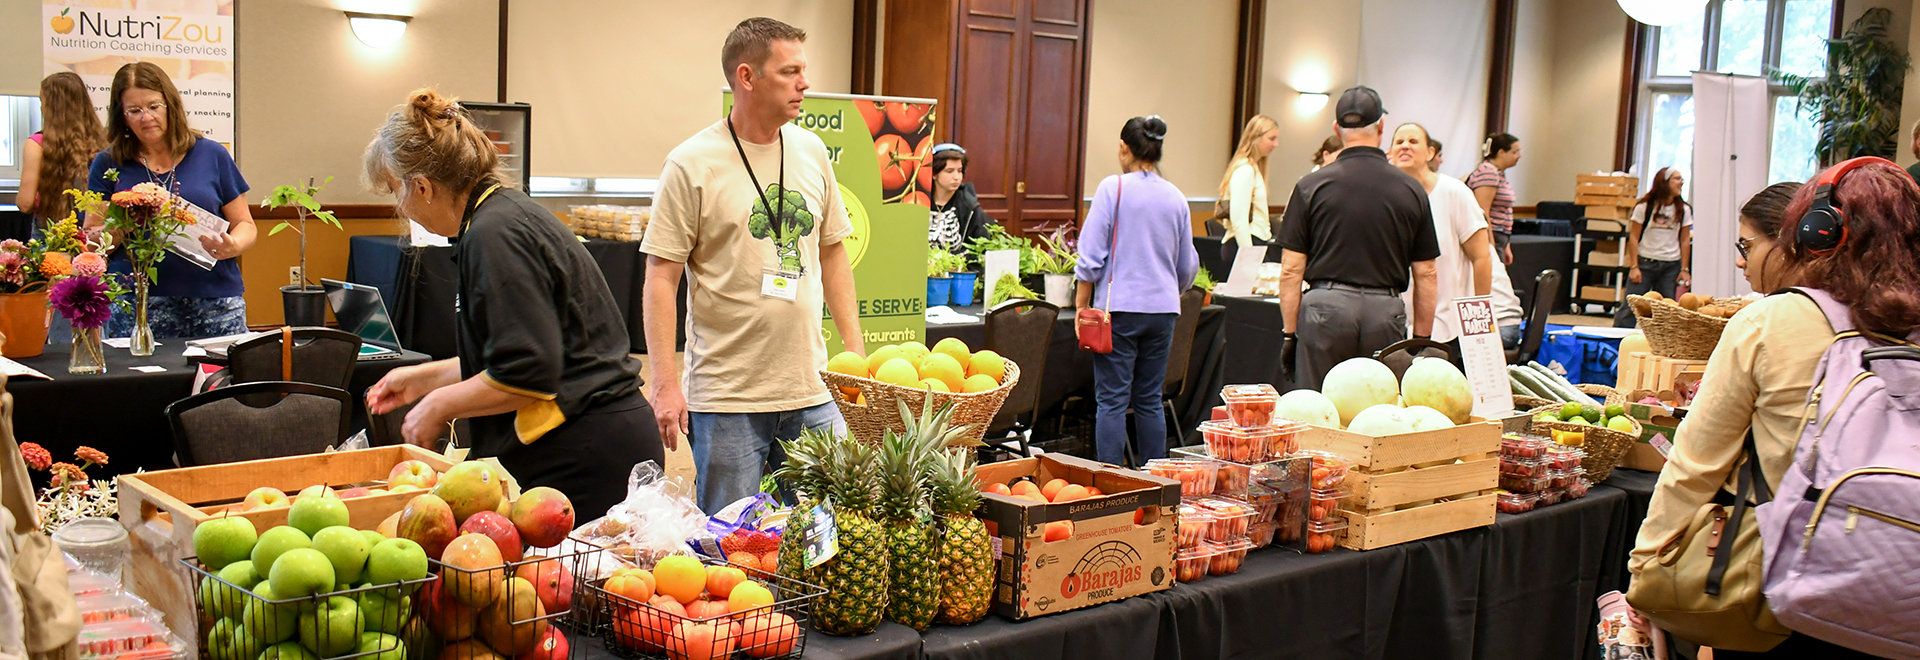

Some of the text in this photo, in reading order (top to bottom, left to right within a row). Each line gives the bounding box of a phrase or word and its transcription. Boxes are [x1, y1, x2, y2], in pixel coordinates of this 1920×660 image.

[80, 11, 222, 44] NutriZou
[51, 36, 227, 56] Nutrition Coaching Services
[194, 89, 231, 98] planning
[194, 109, 231, 118] snacking
[795, 109, 843, 131] Food
[872, 298, 922, 314] SERVE:
[861, 327, 916, 343] taurants
[1069, 494, 1139, 514] BARAJAS PRODUCE
[1076, 524, 1132, 541] GREENHOUSE TOMATOES
[1081, 564, 1142, 592] Barajas
[1088, 587, 1114, 600] PRODUCE
